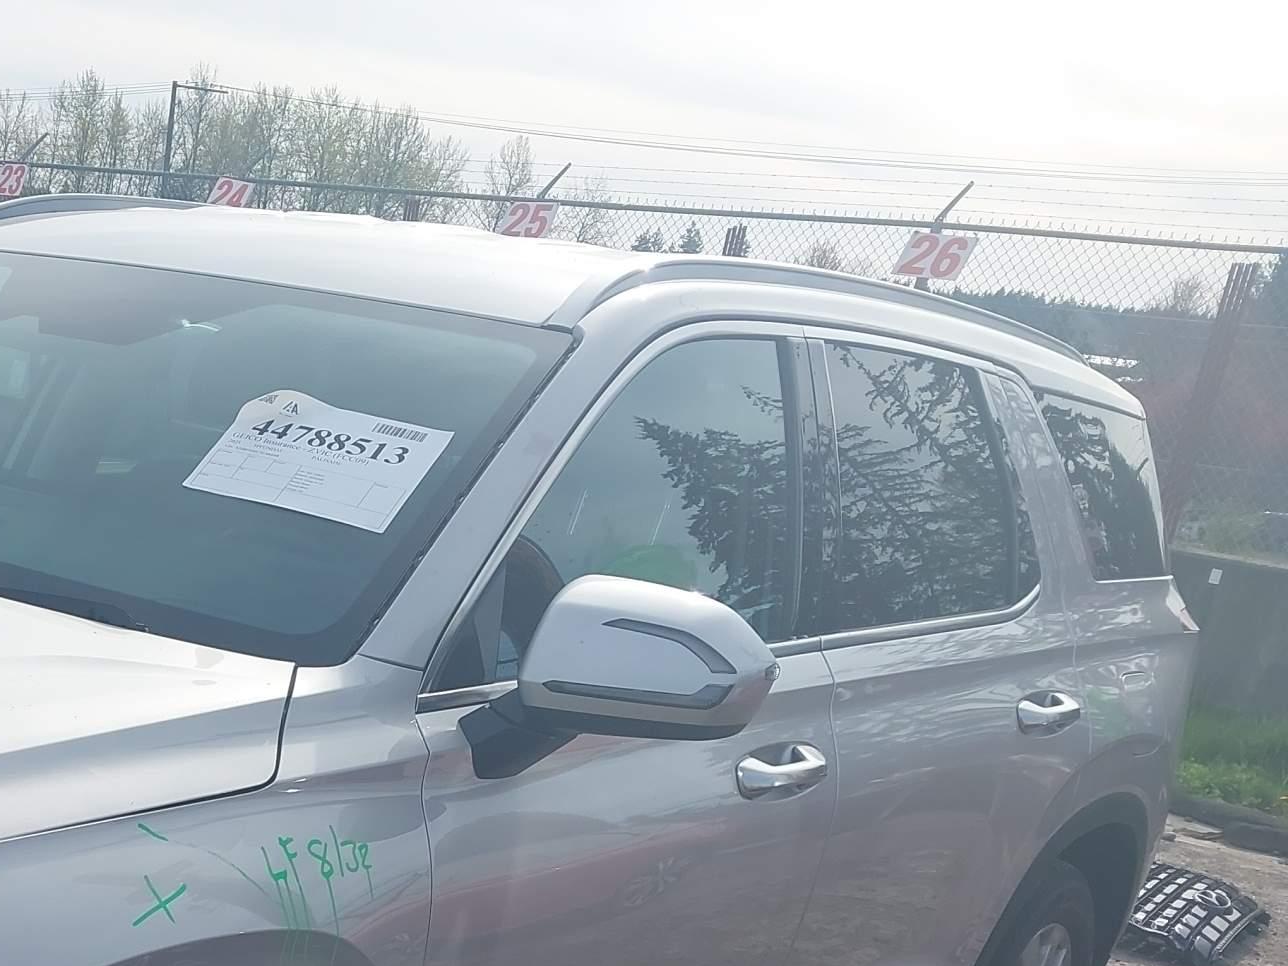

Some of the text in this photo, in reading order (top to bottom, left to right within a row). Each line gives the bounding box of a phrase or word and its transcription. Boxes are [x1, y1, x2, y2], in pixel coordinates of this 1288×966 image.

[213, 179, 249, 206] 24
[501, 203, 554, 238] 25
[899, 235, 968, 277] 26
[232, 431, 263, 443] GEICO
[252, 419, 410, 465] 44788513
